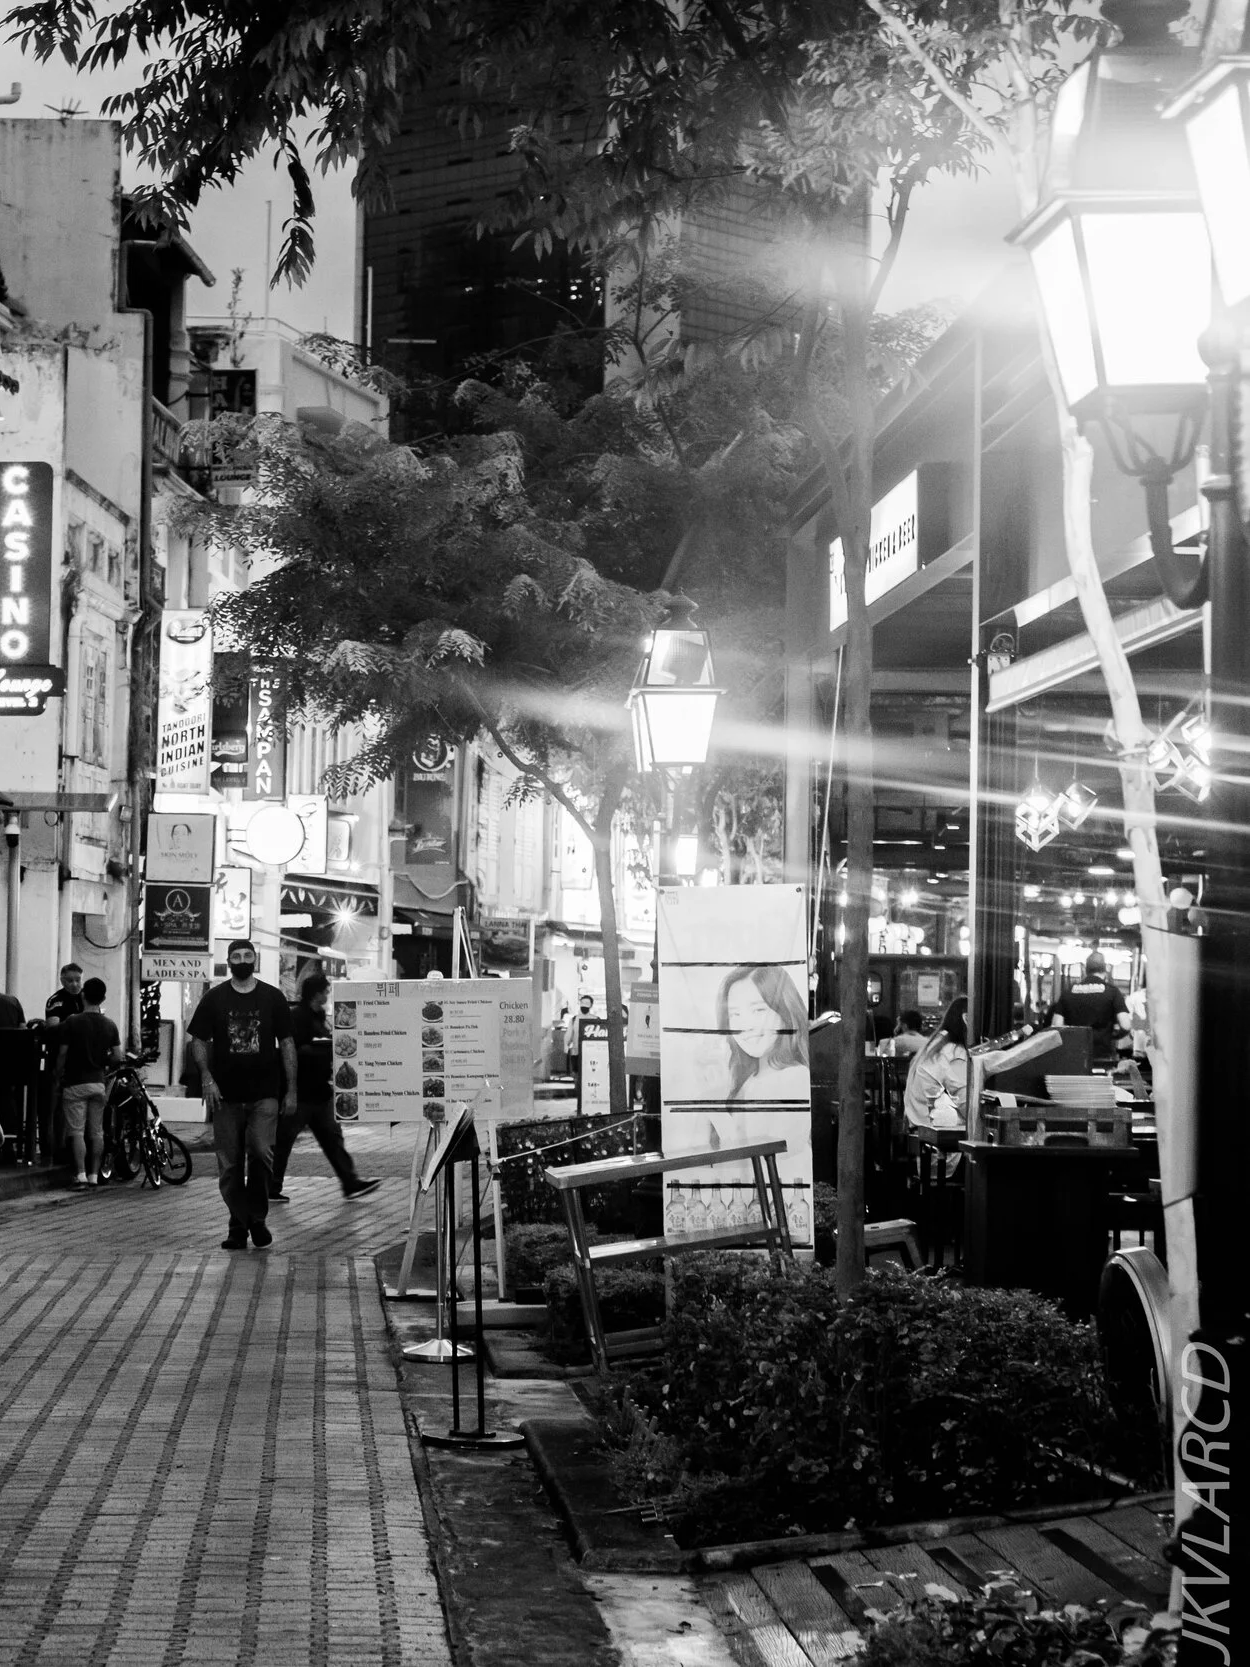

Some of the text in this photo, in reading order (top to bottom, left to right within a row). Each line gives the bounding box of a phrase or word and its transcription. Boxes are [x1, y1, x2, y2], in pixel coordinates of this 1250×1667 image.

[0, 464, 34, 661] CASINO
[161, 724, 205, 749] NORTH
[255, 689, 273, 795] SAMPAN
[161, 740, 205, 765] INDIAN
[211, 740, 246, 755] arlsberg
[160, 756, 204, 777] CUISINE
[152, 958, 202, 968] MEN AND
[146, 969, 207, 979] LADIES SPA
[499, 1001, 529, 1010] Chicken
[503, 1015, 525, 1024] 28.80
